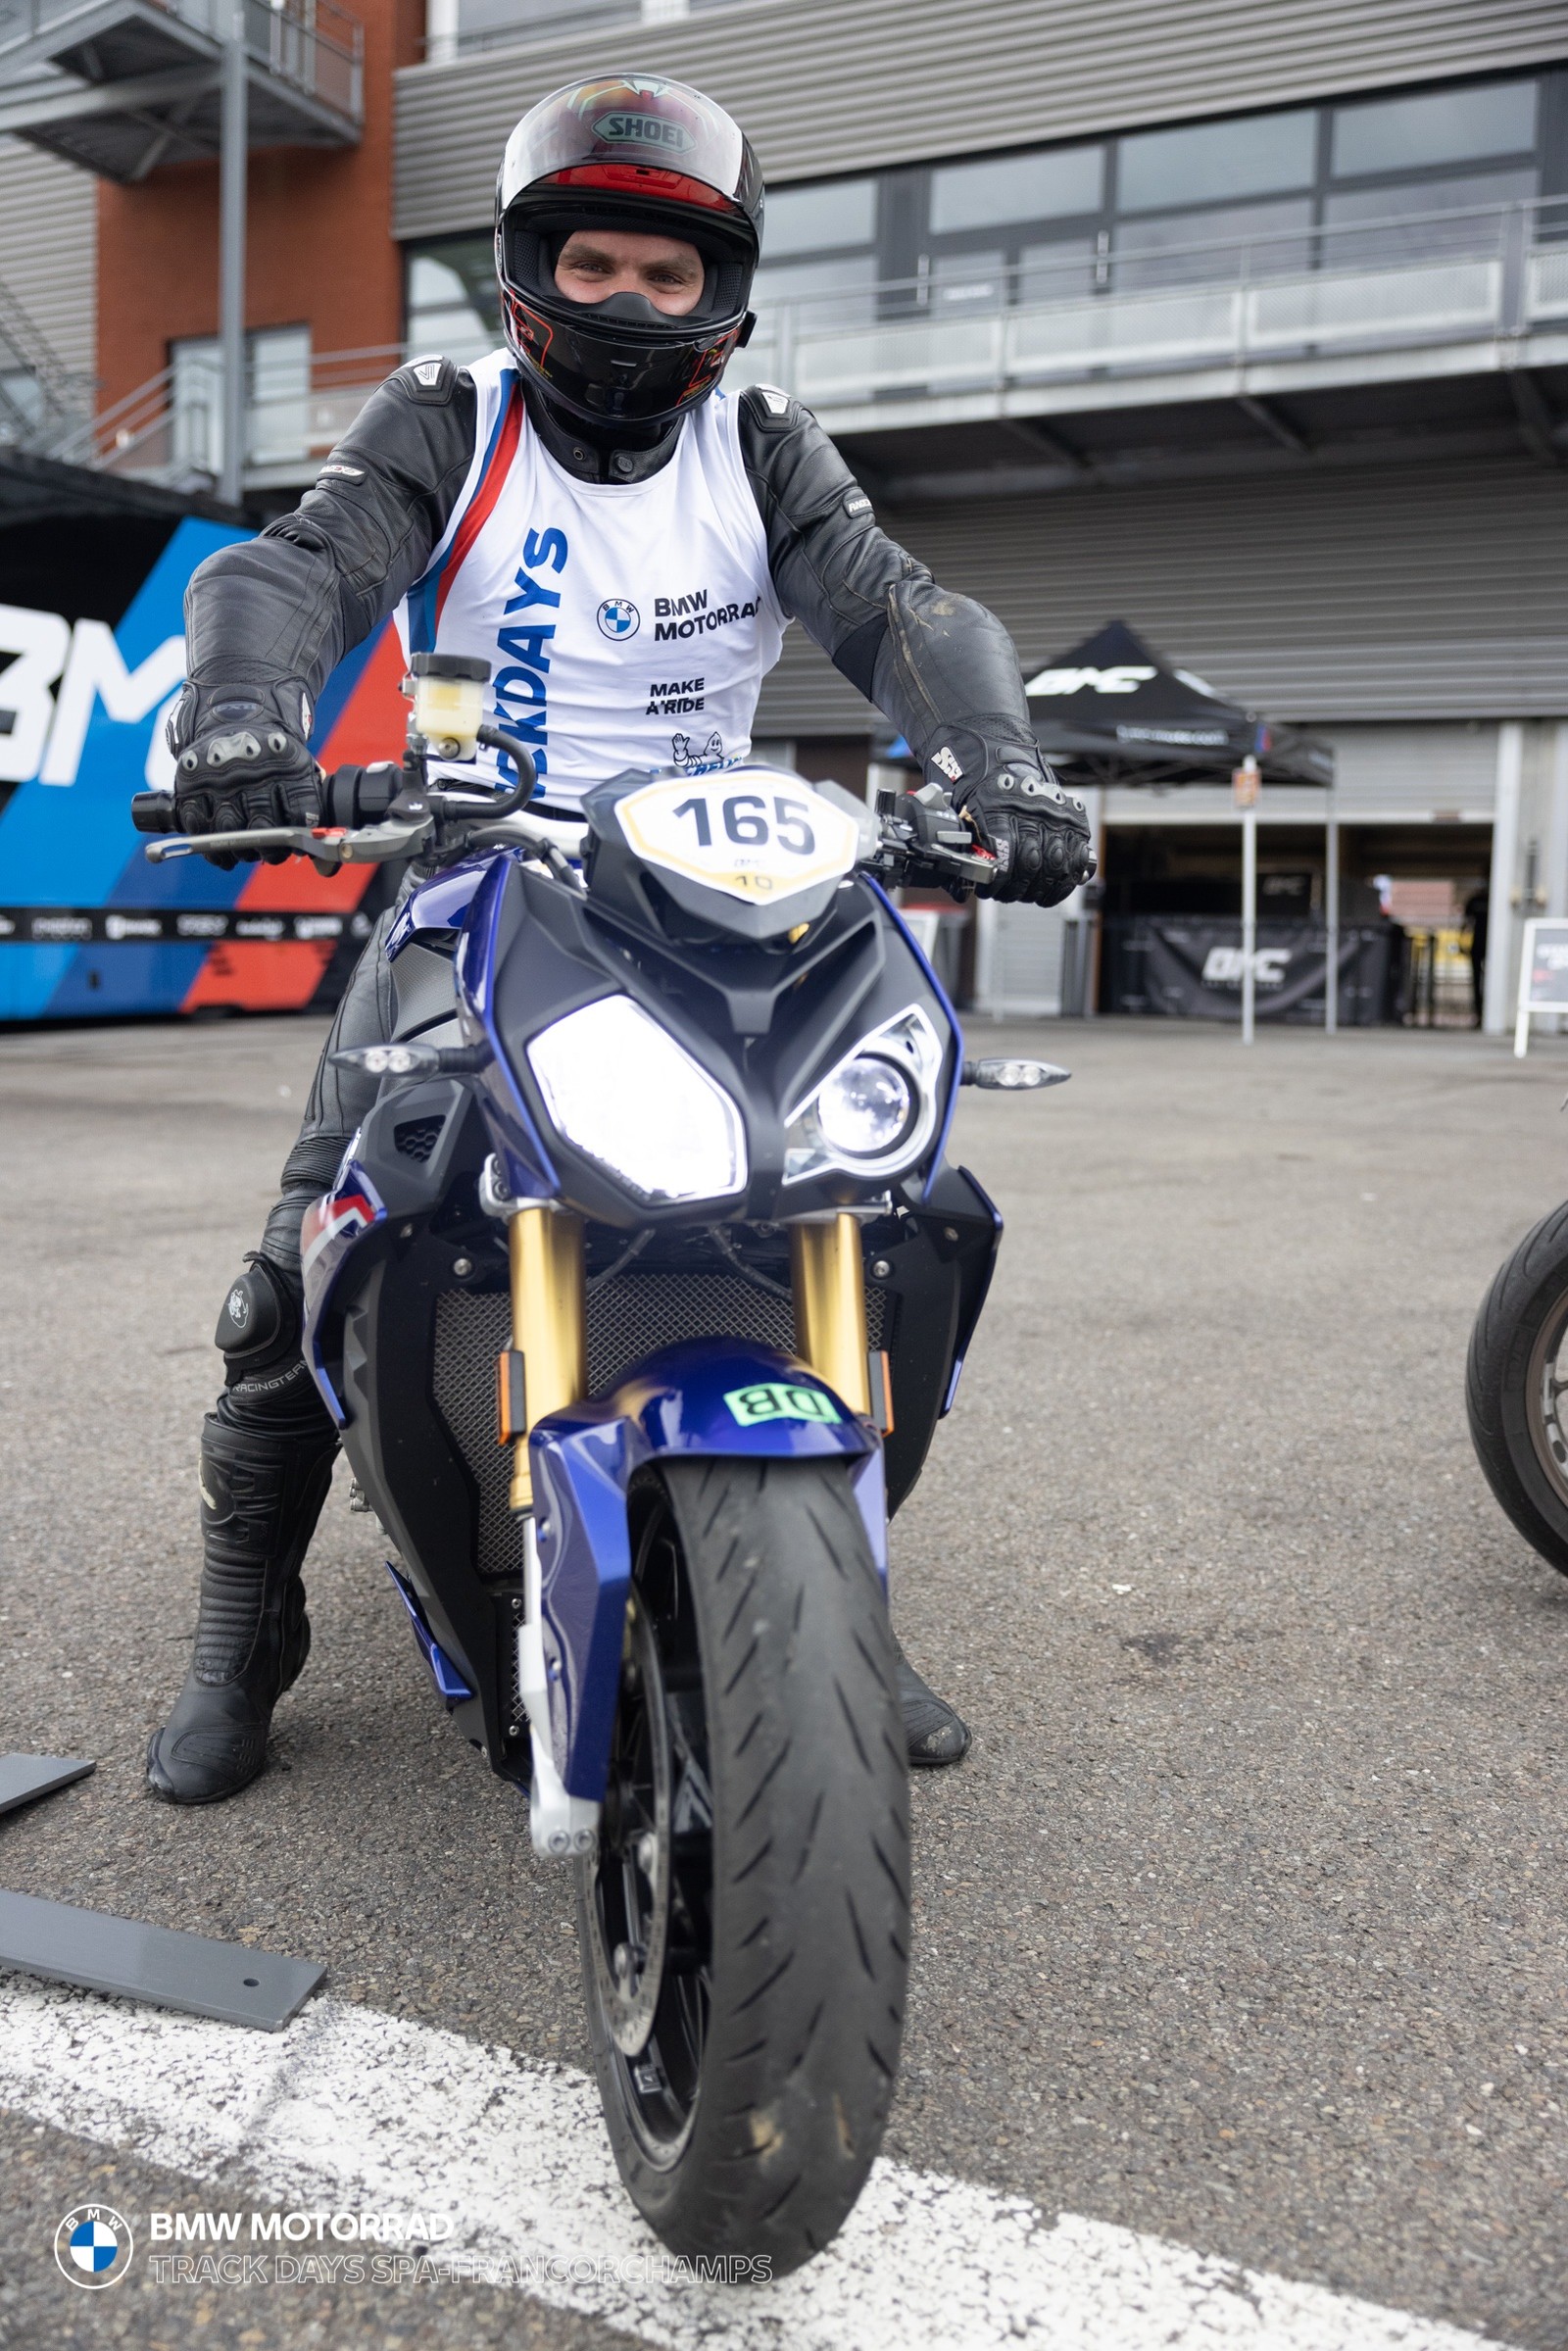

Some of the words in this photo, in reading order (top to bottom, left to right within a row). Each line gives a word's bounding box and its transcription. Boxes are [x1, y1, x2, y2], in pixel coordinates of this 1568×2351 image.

[609, 118, 683, 148] SHOEI
[655, 589, 708, 617] BMW
[493, 527, 568, 798] CKDAYS
[650, 677, 705, 697] MAKE
[646, 701, 660, 715] A
[663, 698, 705, 714] RIDE
[672, 795, 815, 856] 165
